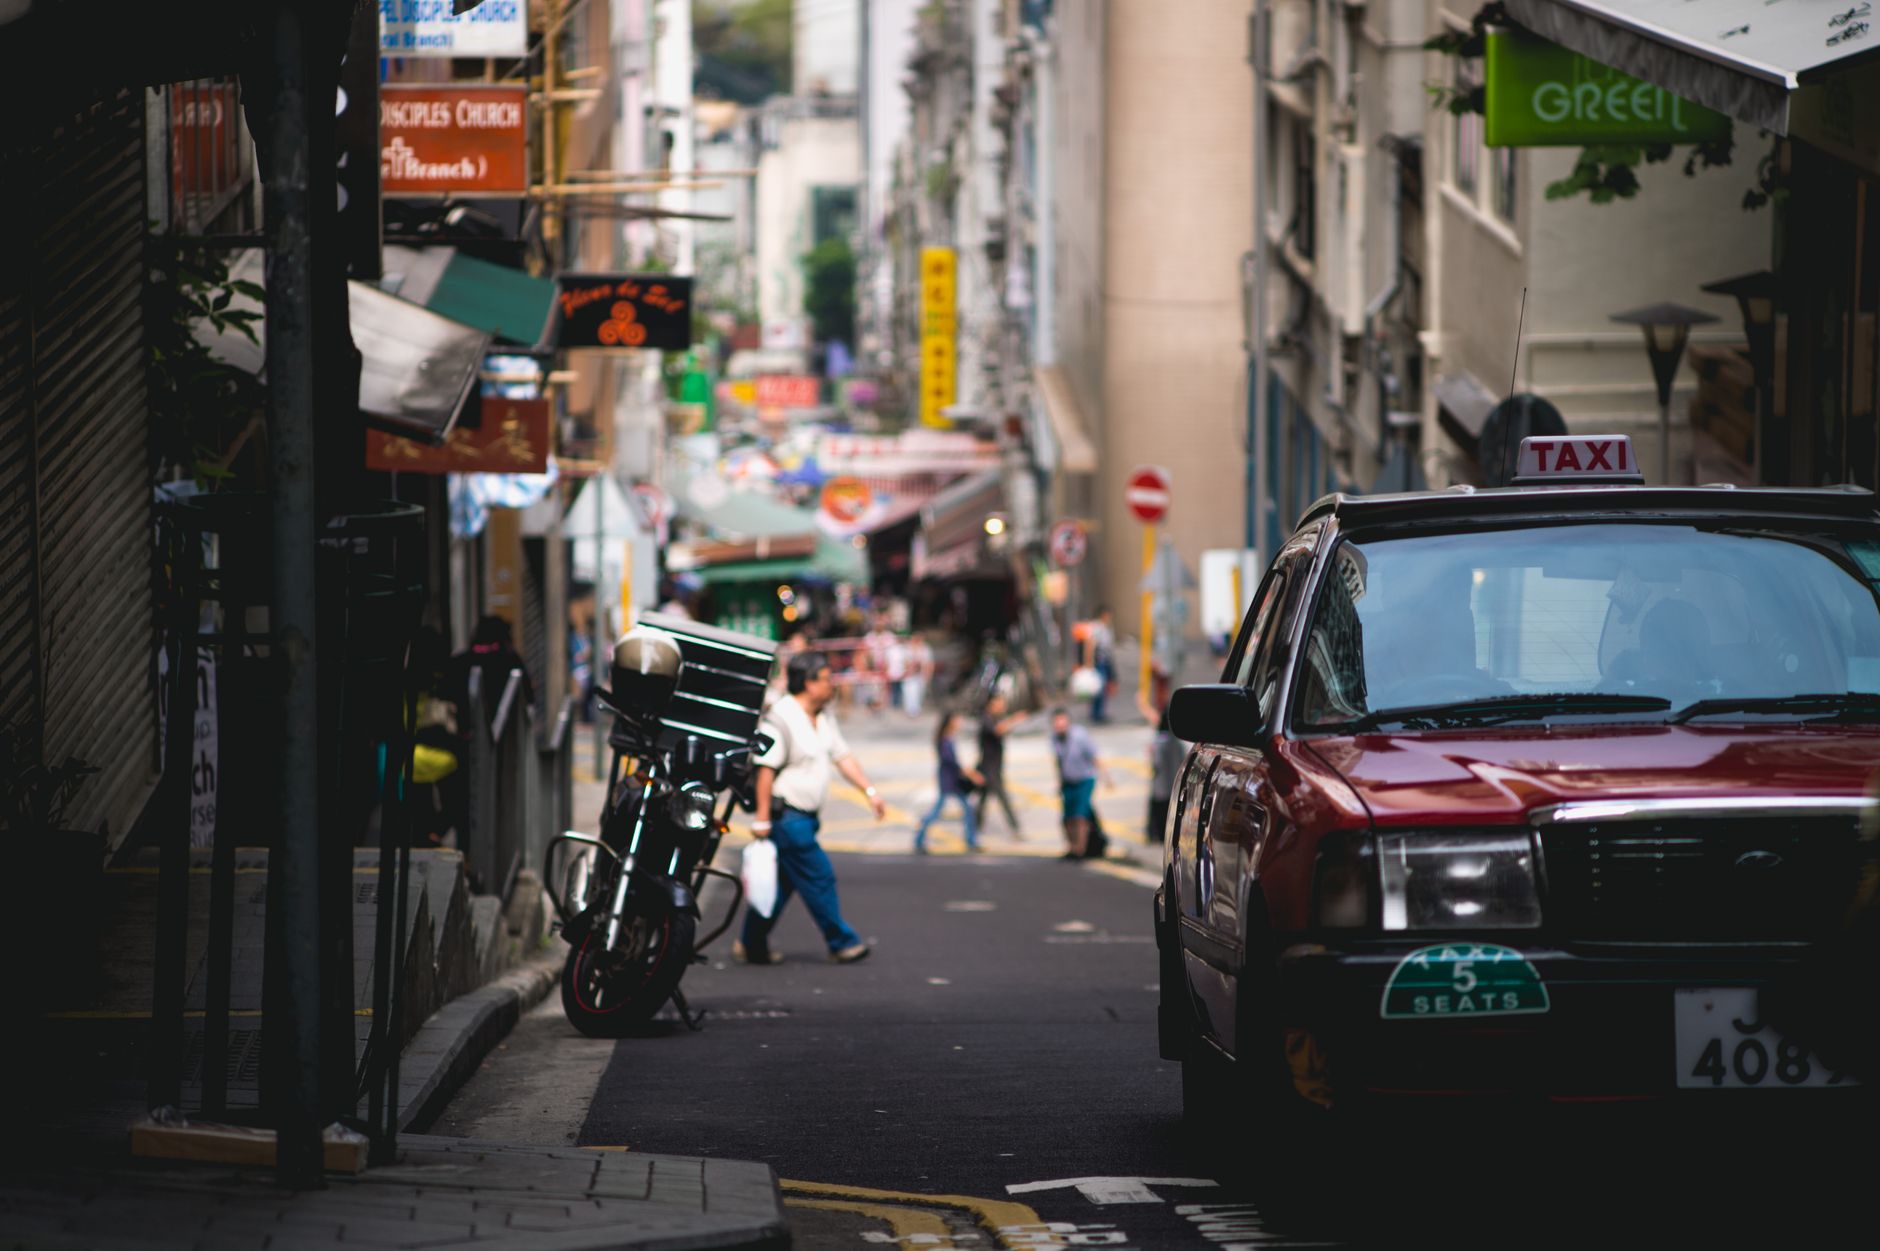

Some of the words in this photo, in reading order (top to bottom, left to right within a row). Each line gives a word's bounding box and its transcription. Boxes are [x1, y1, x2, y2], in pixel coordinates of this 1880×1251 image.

[1532, 81, 1687, 132] GREEN
[1530, 441, 1627, 472] TAXI
[1453, 961, 1477, 993] 5
[1414, 992, 1519, 1014] SEATS
